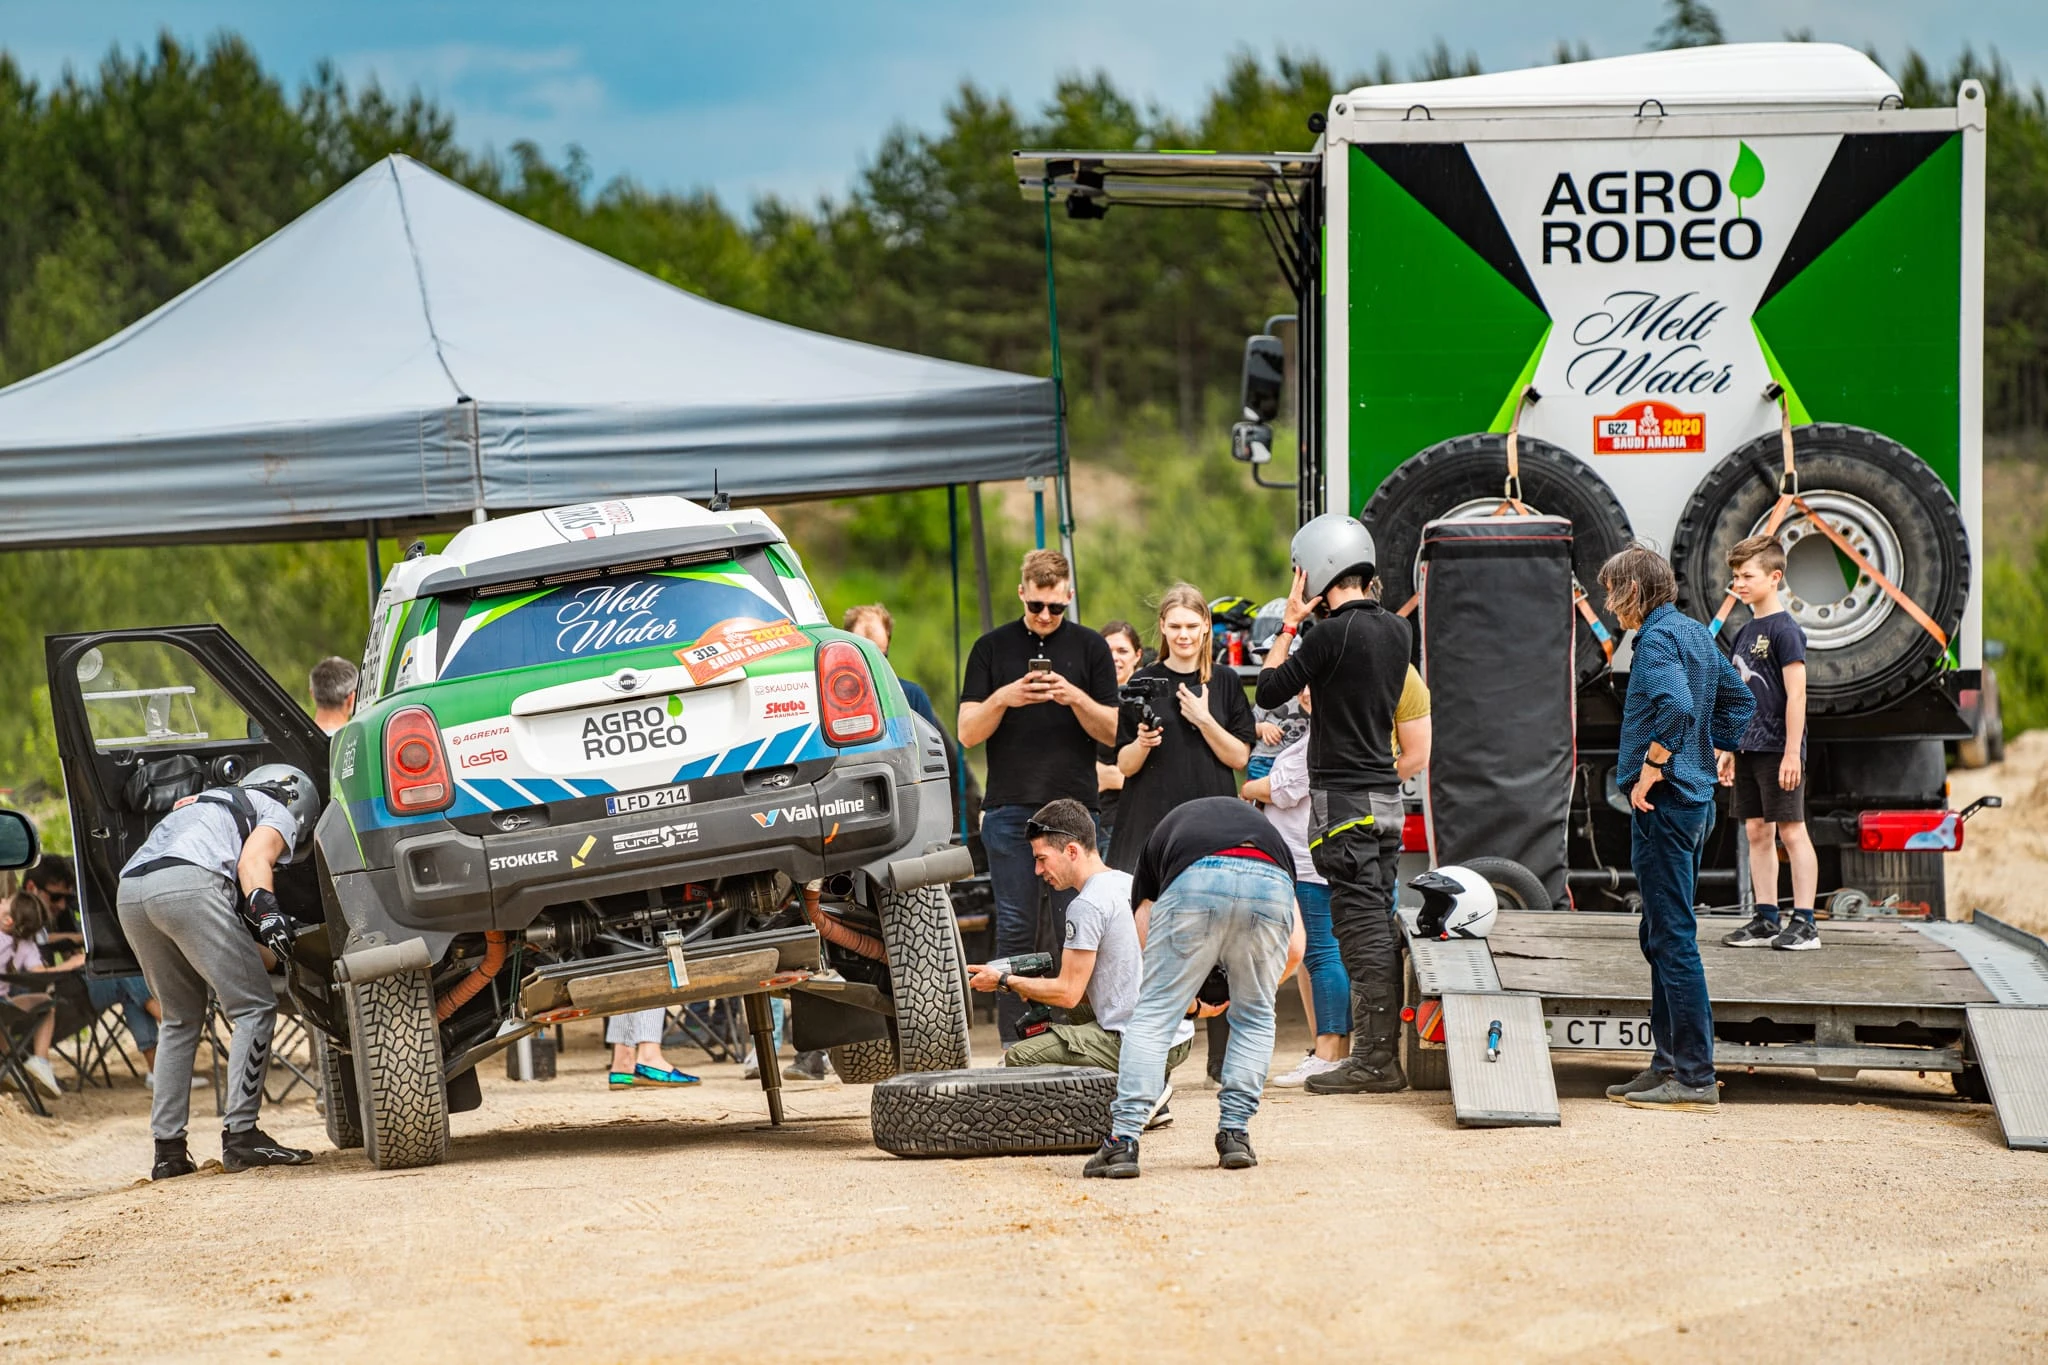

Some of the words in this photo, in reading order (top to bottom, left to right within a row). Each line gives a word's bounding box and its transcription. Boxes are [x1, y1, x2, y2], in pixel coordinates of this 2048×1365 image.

[1541, 169, 1722, 216] AGRO
[1543, 217, 1763, 264] RODEO
[1573, 290, 1728, 346] Melt
[1566, 344, 1734, 396] Water
[1608, 422, 1628, 435] 622
[1663, 418, 1701, 436] 2020
[1612, 436, 1645, 450] SAUDI
[1646, 435, 1687, 449] ARABIA
[556, 581, 666, 625] Melt
[556, 610, 678, 654] Water
[693, 645, 719, 661] 319
[751, 624, 794, 642] 2020
[707, 650, 746, 670] SAUDI
[745, 637, 790, 657] ARABIA
[619, 678, 636, 687] MINI
[765, 682, 810, 694] SKAUDUVA
[463, 726, 510, 742] AGRENTA
[582, 706, 665, 739] AGRO
[583, 725, 687, 761] RODEO
[460, 748, 508, 769] Lesta
[617, 794, 650, 812] LFD
[655, 788, 687, 806] 214
[781, 799, 865, 823] Valvoline
[489, 850, 559, 871] STOKKER
[1567, 1019, 1607, 1045] CT
